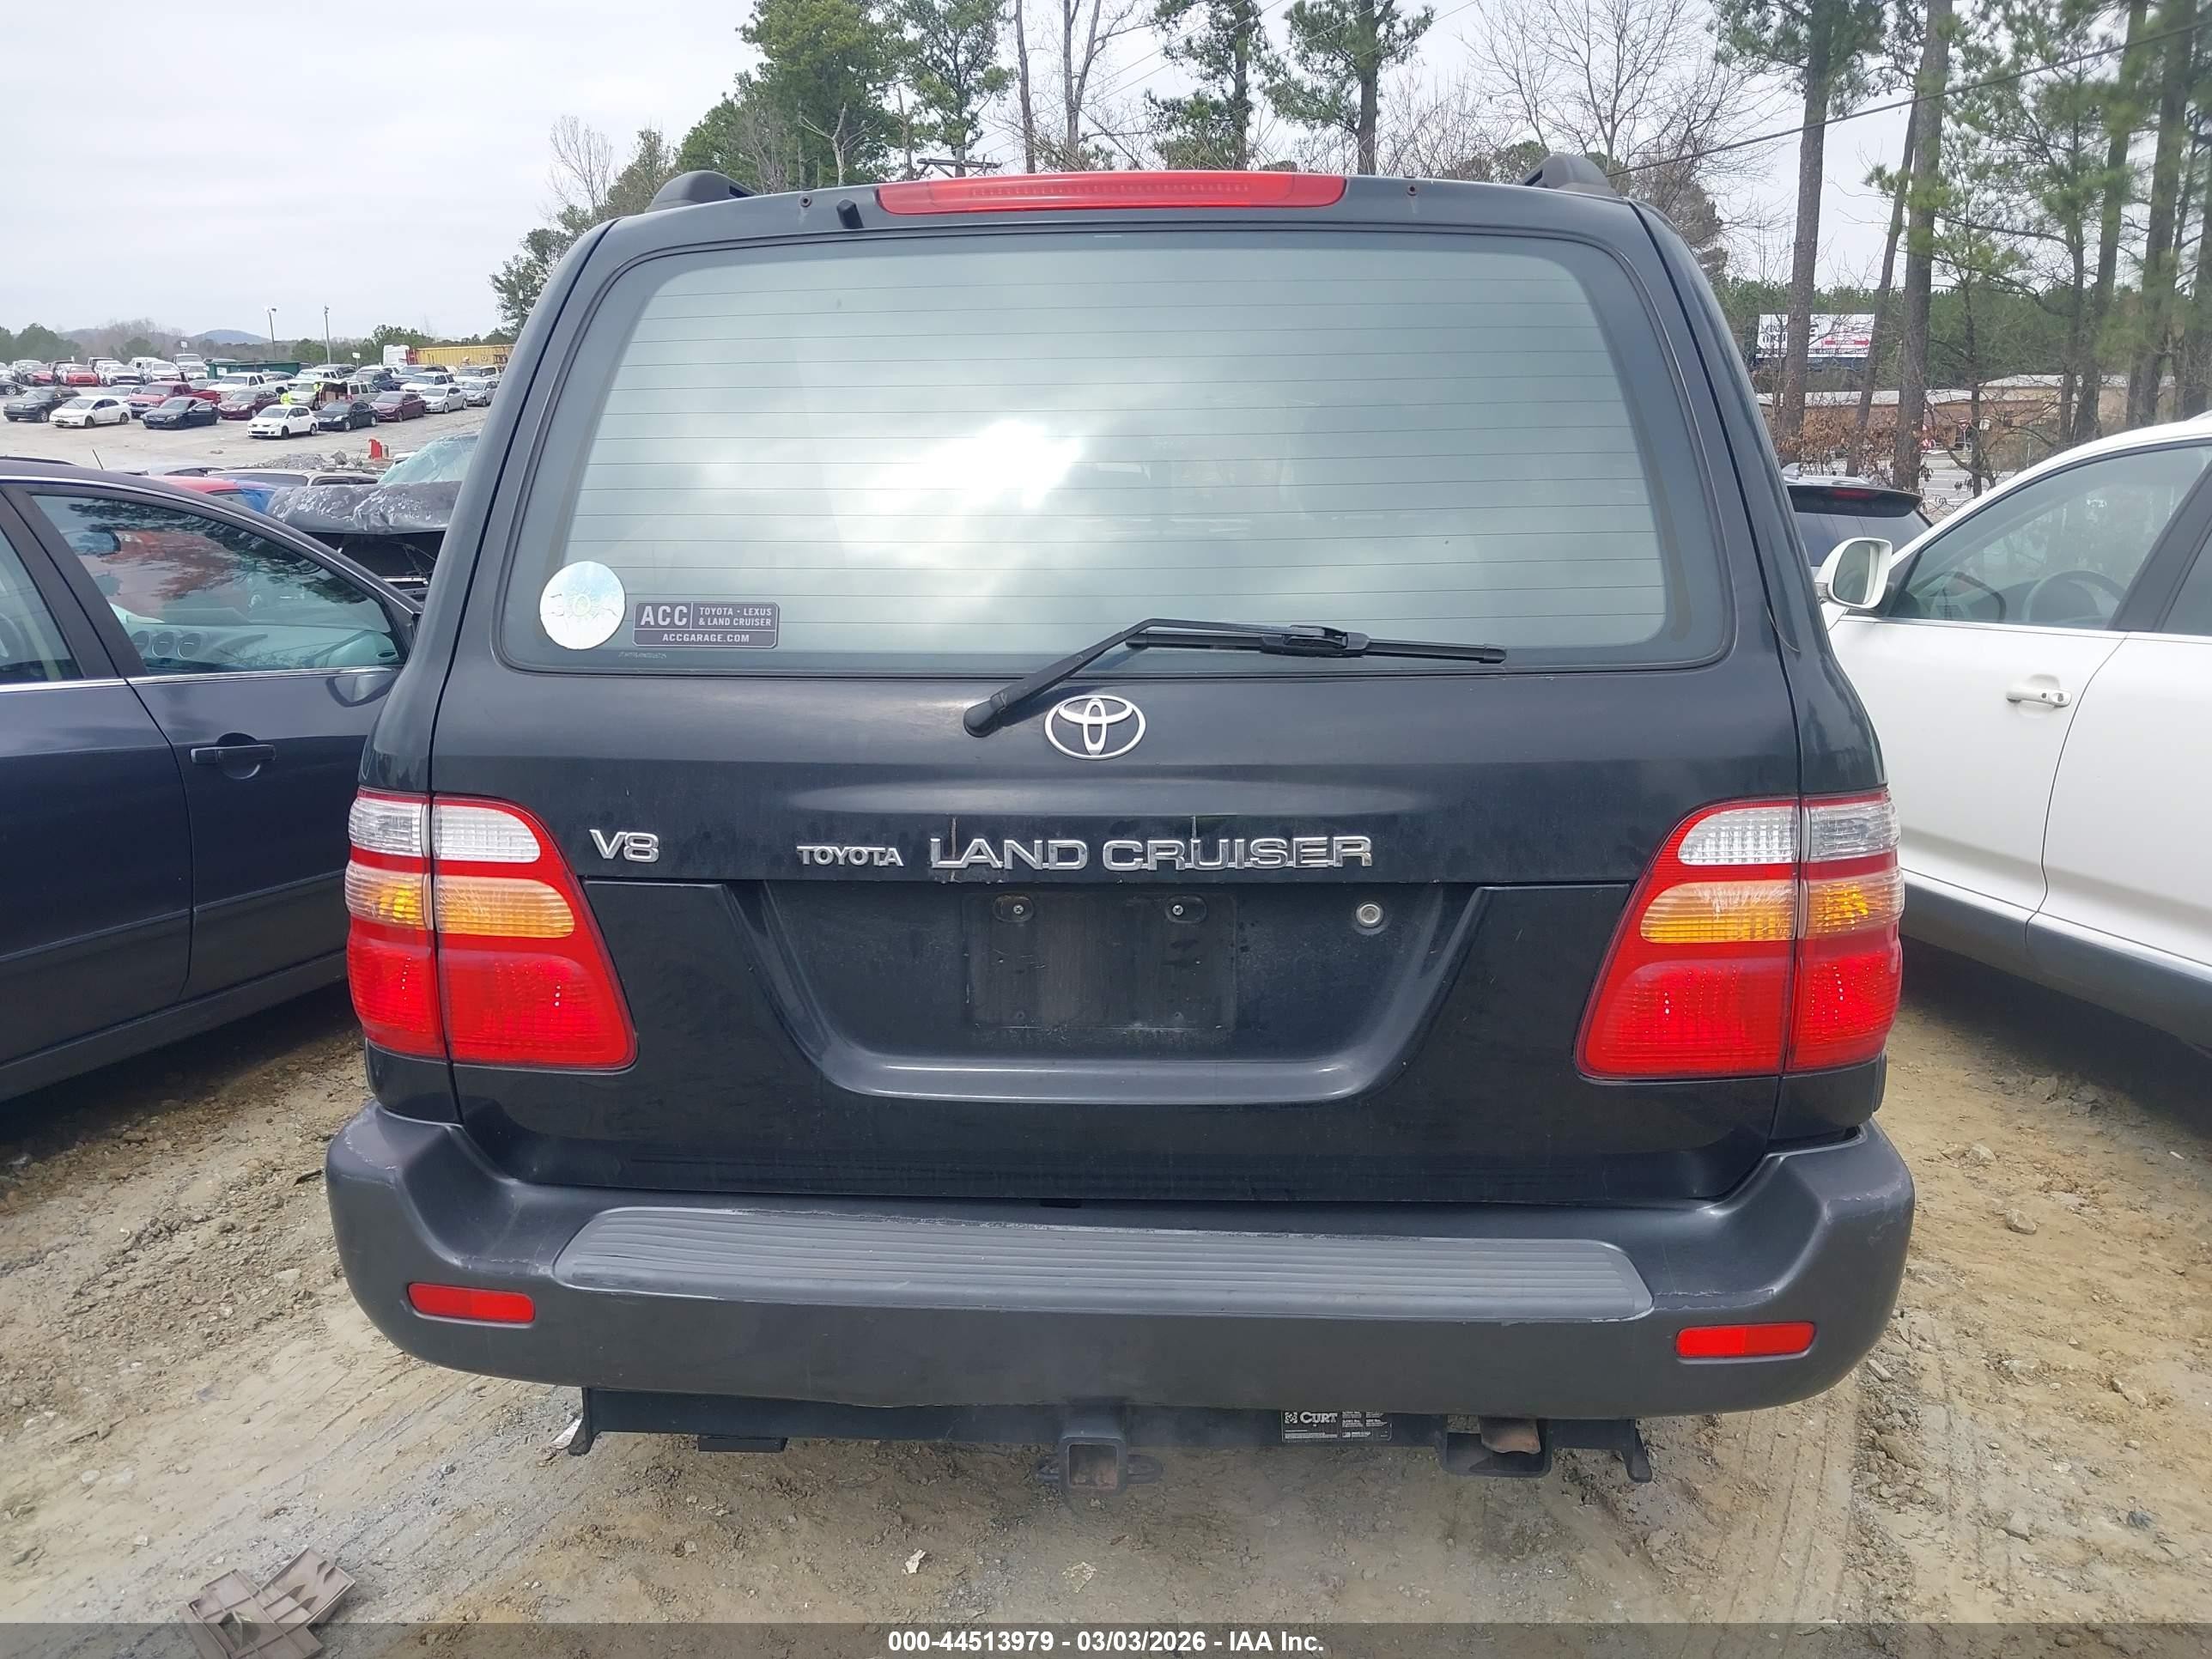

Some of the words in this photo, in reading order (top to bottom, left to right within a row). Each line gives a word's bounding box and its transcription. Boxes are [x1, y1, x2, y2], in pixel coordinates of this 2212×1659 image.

[640, 605, 688, 627] ACC
[699, 606, 733, 616] TOYOTA
[743, 607, 772, 617] LEXUS
[698, 617, 706, 625] &
[708, 617, 730, 626] LAND
[732, 617, 771, 627] CRUISER
[662, 633, 750, 643] ACCGARAGE.COM
[588, 829, 659, 863] V8
[796, 845, 905, 866] TOYOTA
[930, 837, 1088, 871] LAND
[1103, 836, 1372, 871] CRUISER
